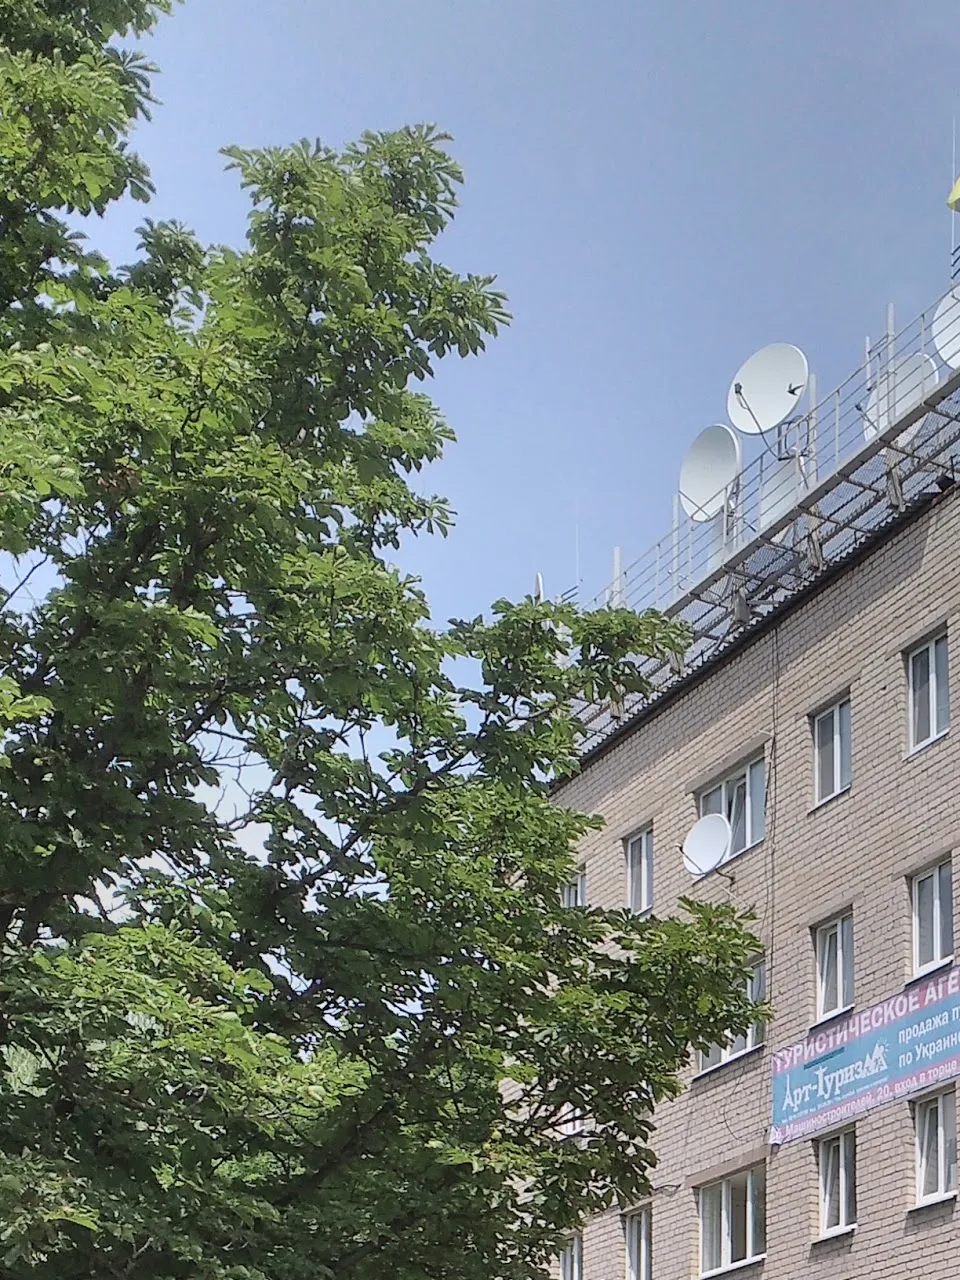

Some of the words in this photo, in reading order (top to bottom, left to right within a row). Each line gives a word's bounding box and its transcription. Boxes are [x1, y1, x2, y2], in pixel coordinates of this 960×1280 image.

[774, 989, 920, 1072] ТУРИСТИЧЕСКОЕ
[899, 1011, 948, 1044] продажа
[894, 1076, 917, 1094] вход
[919, 1072, 926, 1083] в
[928, 1060, 957, 1080] торце
[899, 1053, 912, 1068] по
